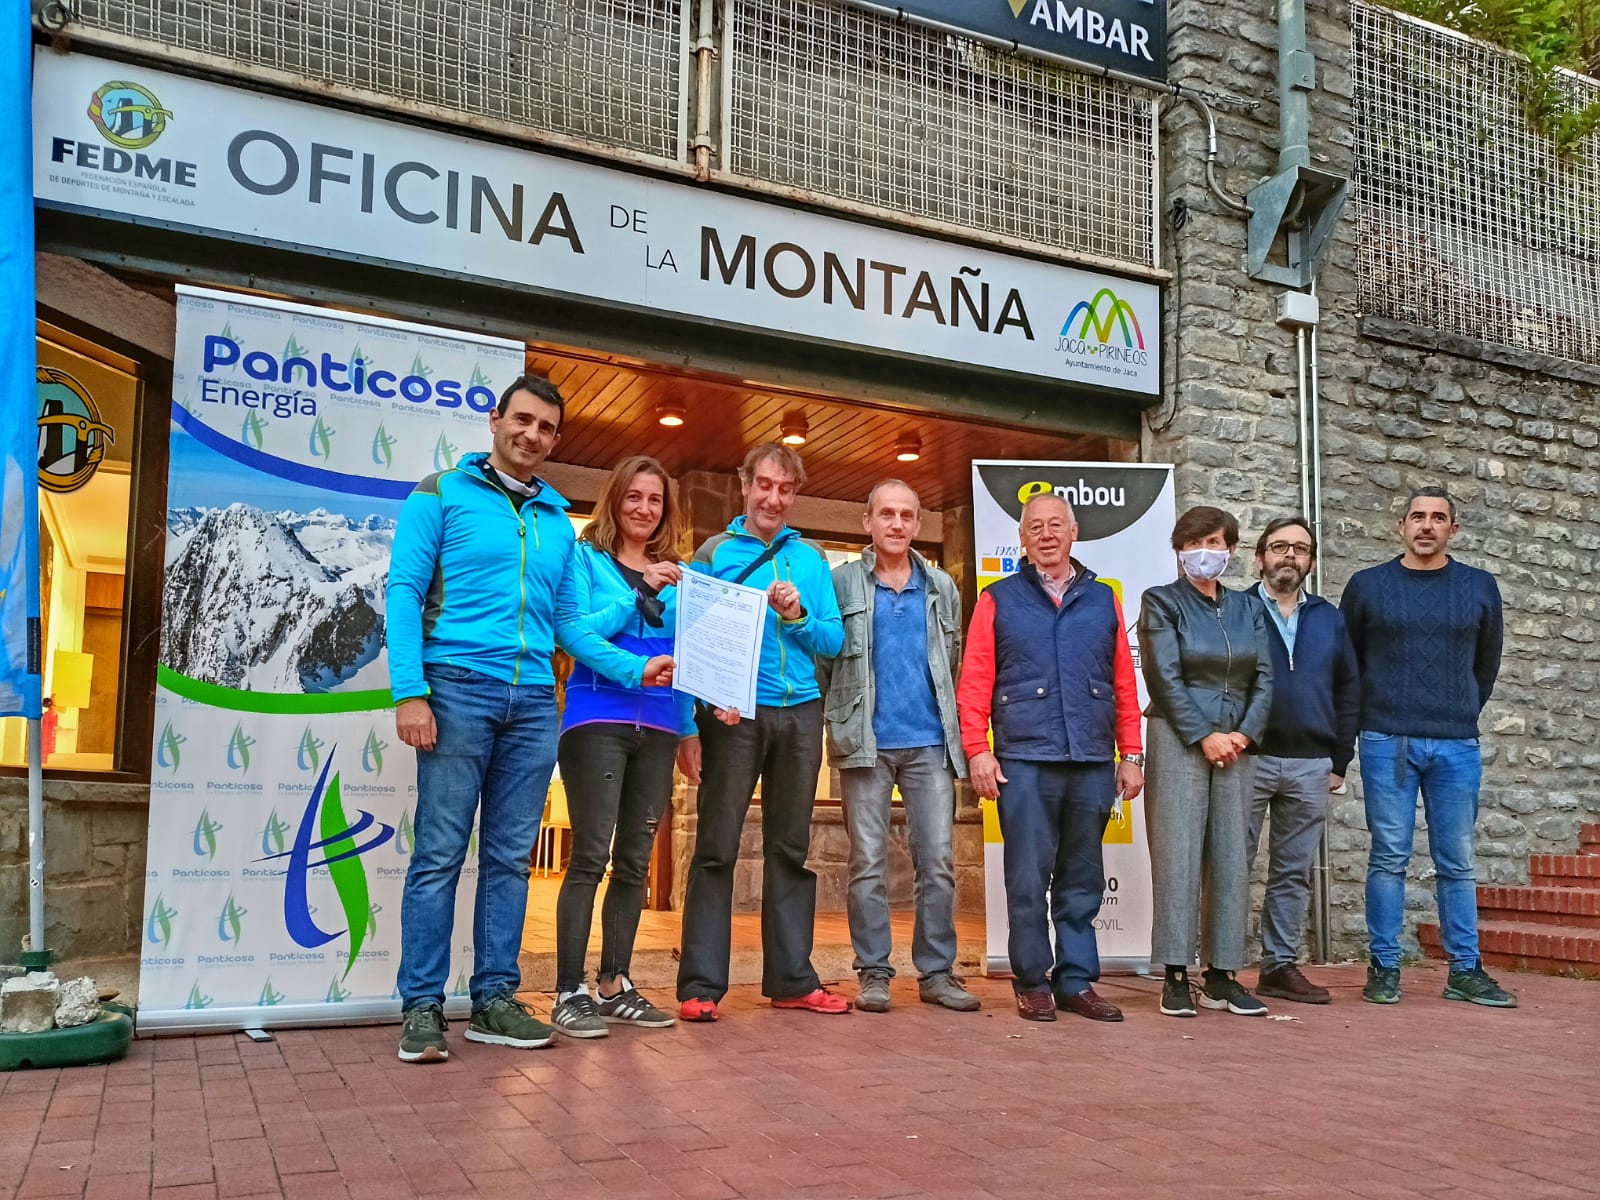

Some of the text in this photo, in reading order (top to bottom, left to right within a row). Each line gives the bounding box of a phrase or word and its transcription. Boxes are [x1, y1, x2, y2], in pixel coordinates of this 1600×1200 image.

[1030, 0, 1154, 61] AMBAR
[51, 136, 197, 188] FEDME
[50, 175, 60, 183] DE
[61, 176, 100, 190] DEPORTES
[101, 184, 110, 192] DE
[113, 185, 150, 199] MONTAÑA
[81, 171, 167, 193] FEDERACIÓN ESPAÑOLA
[227, 129, 585, 254] OFICINA
[610, 204, 647, 234] DE
[645, 245, 678, 273] LA
[700, 225, 1035, 341] MONTAÑA
[227, 304, 281, 320] Panticosa
[292, 315, 344, 330] Panticosa
[357, 325, 407, 341] Panticosa
[418, 335, 466, 351] Panticosa
[1065, 358, 1111, 373] Ayuntamiento
[1123, 368, 1138, 377] Jaca
[1098, 344, 1148, 366] PIRINEOS
[204, 335, 496, 413] Panticosa
[201, 378, 317, 418] Energía
[330, 393, 381, 407] Panticosa
[392, 402, 441, 416] Panticosa
[1017, 478, 1125, 507] embou
[207, 781, 263, 790] Panticosa
[343, 784, 396, 792] Panticosa
[172, 869, 230, 877] Panticosa
[197, 955, 255, 963] Panticosa
[270, 952, 325, 961] Panticosa
[336, 950, 389, 958] Paticosa
